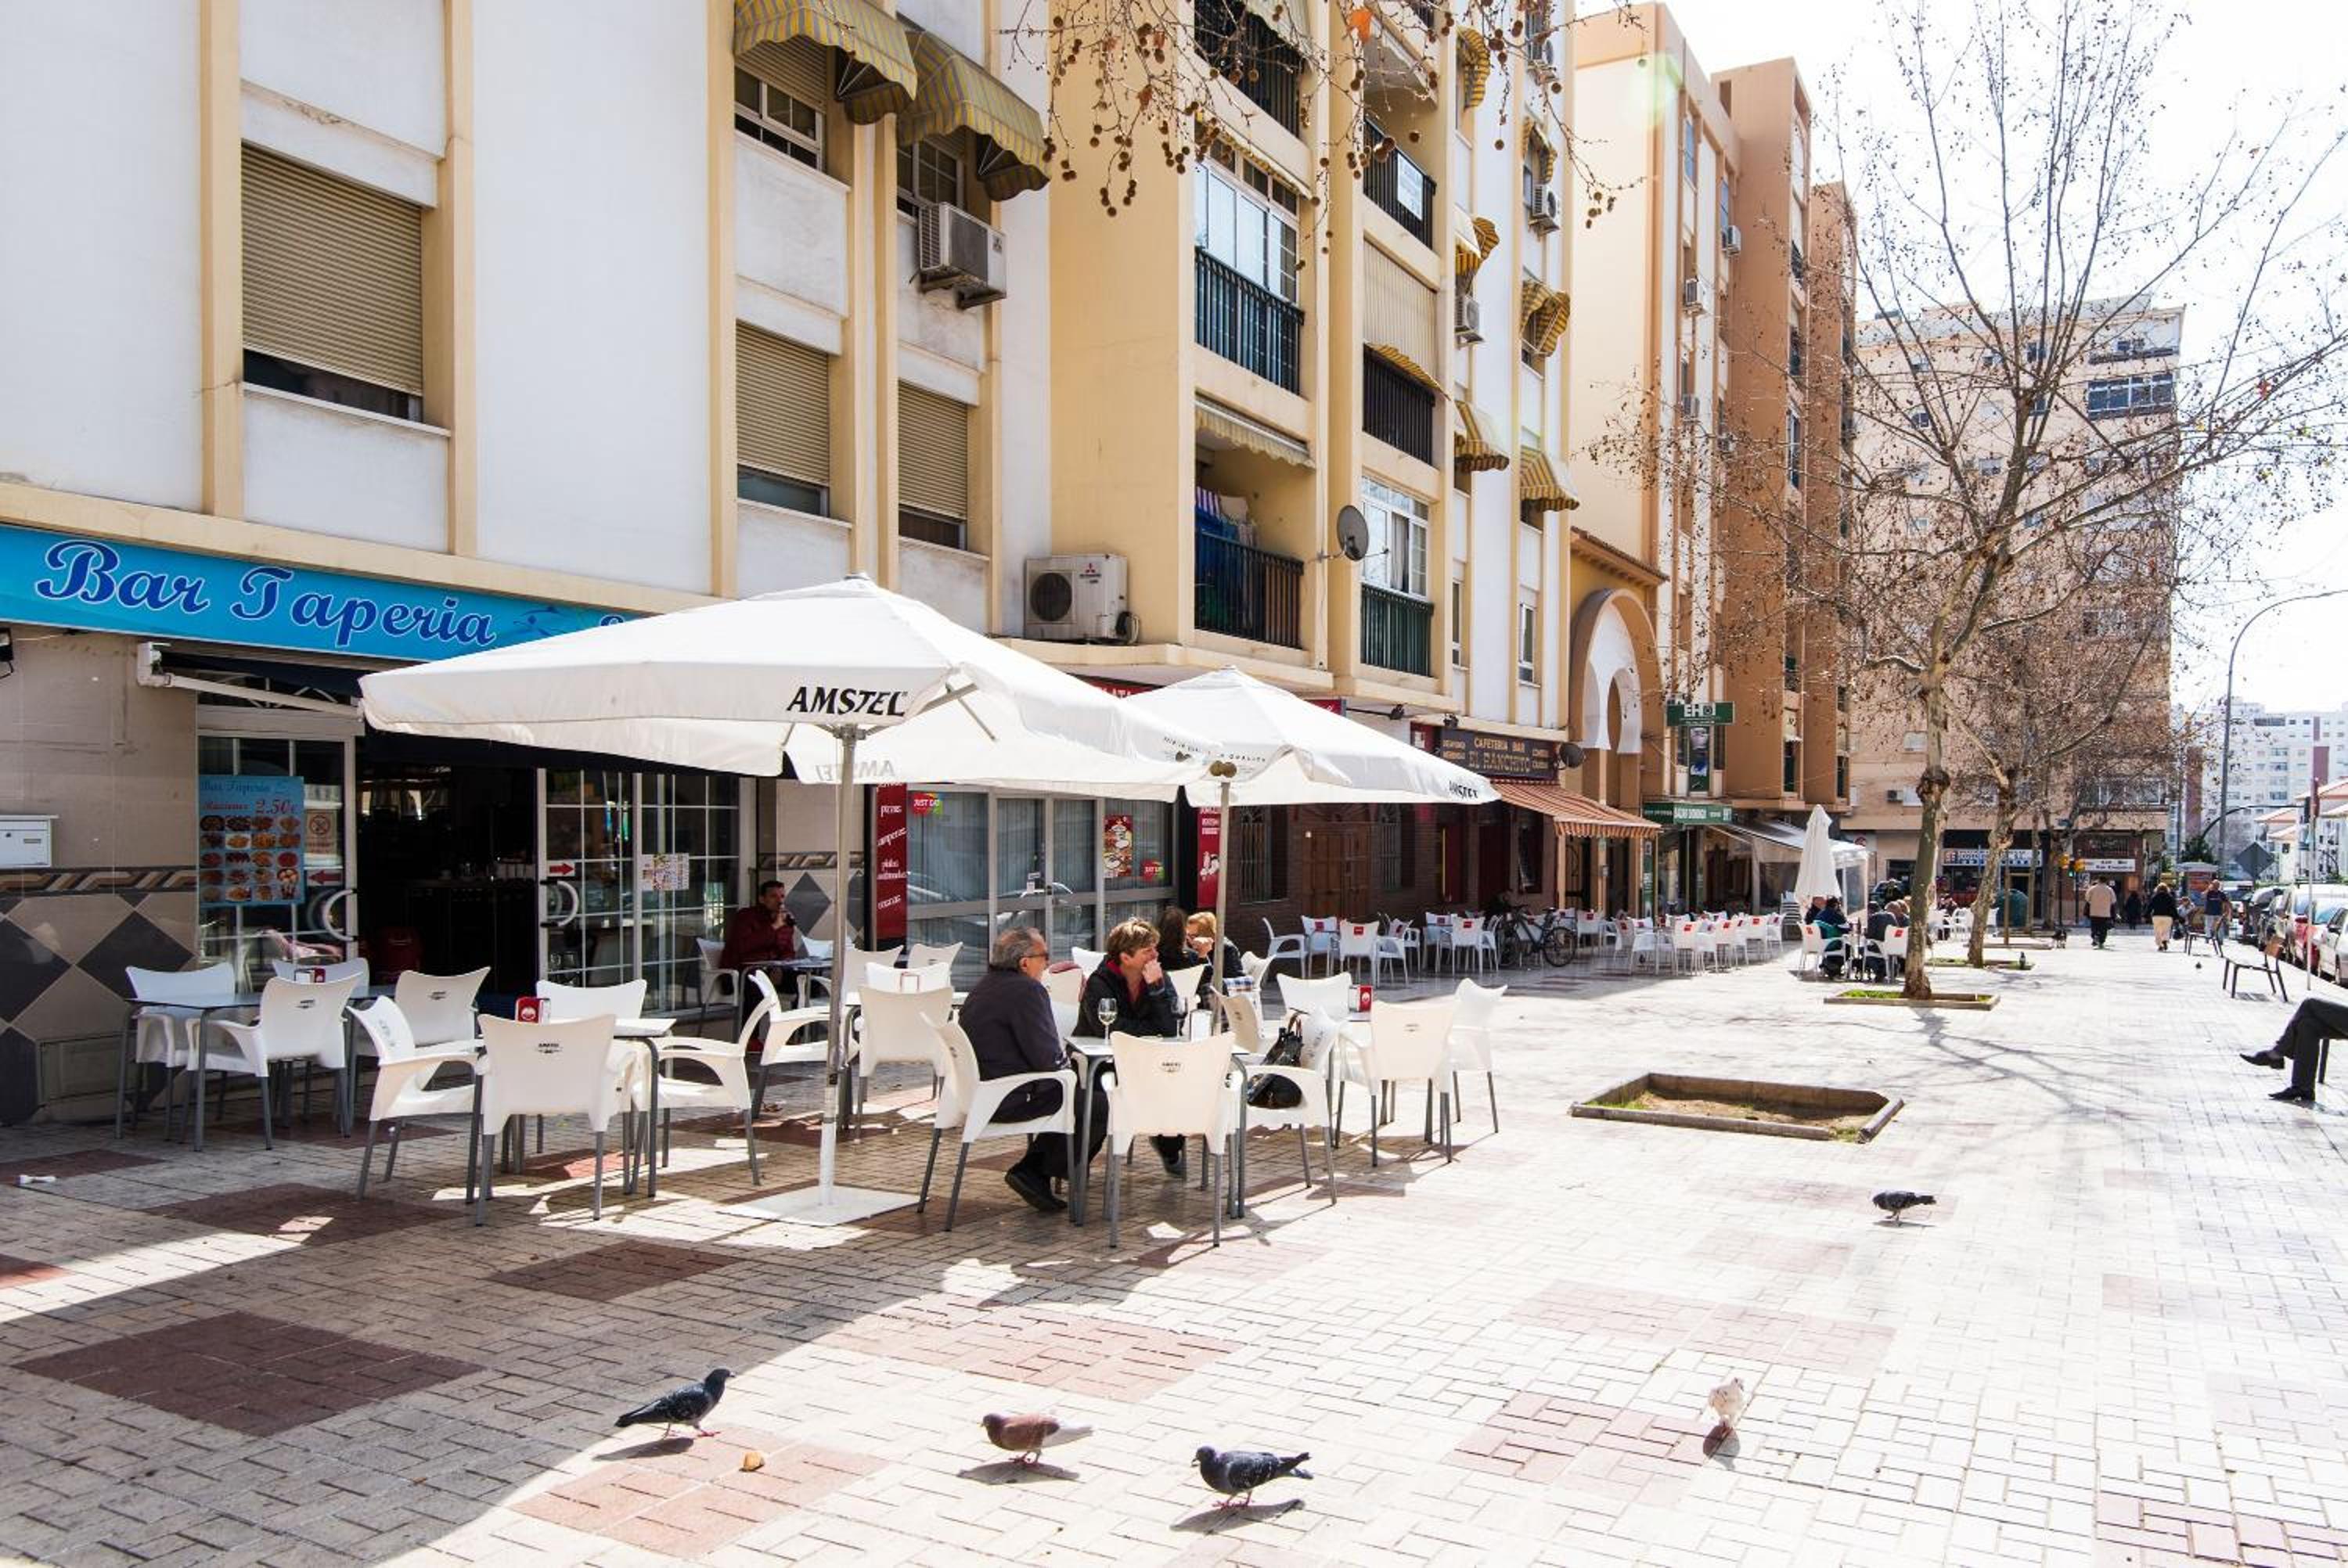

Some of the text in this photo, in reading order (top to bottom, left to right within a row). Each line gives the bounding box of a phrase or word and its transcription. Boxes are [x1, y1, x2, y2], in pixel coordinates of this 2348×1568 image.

[34, 540, 498, 649] Bar Taperia
[787, 685, 906, 717] AMSTEL
